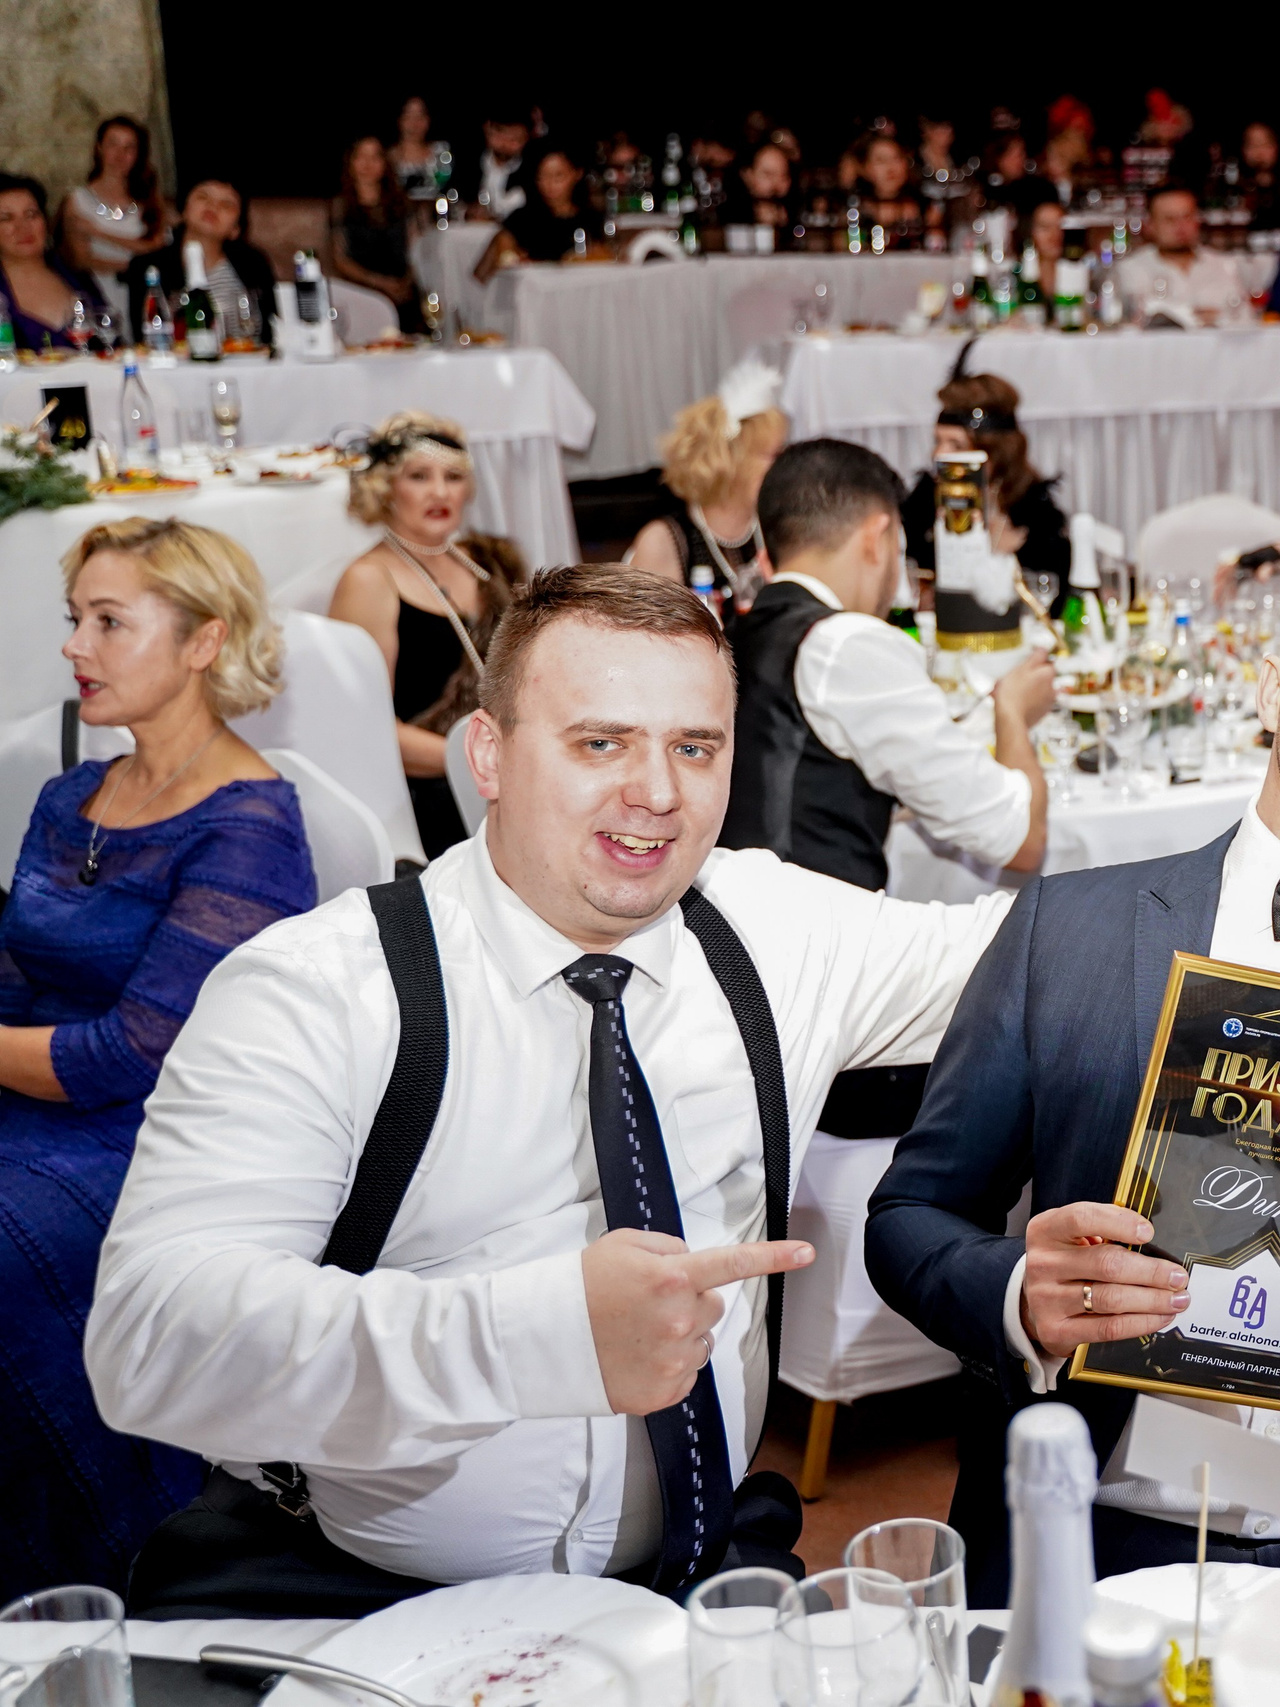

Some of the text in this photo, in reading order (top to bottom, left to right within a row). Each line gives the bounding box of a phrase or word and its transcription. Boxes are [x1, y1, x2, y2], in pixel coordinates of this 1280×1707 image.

[1235, 1138, 1272, 1151] Ежегодная
[1247, 1150, 1274, 1161] лучших
[1180, 1352, 1246, 1370] ГЕНЕРАЛЬНЫЙ
